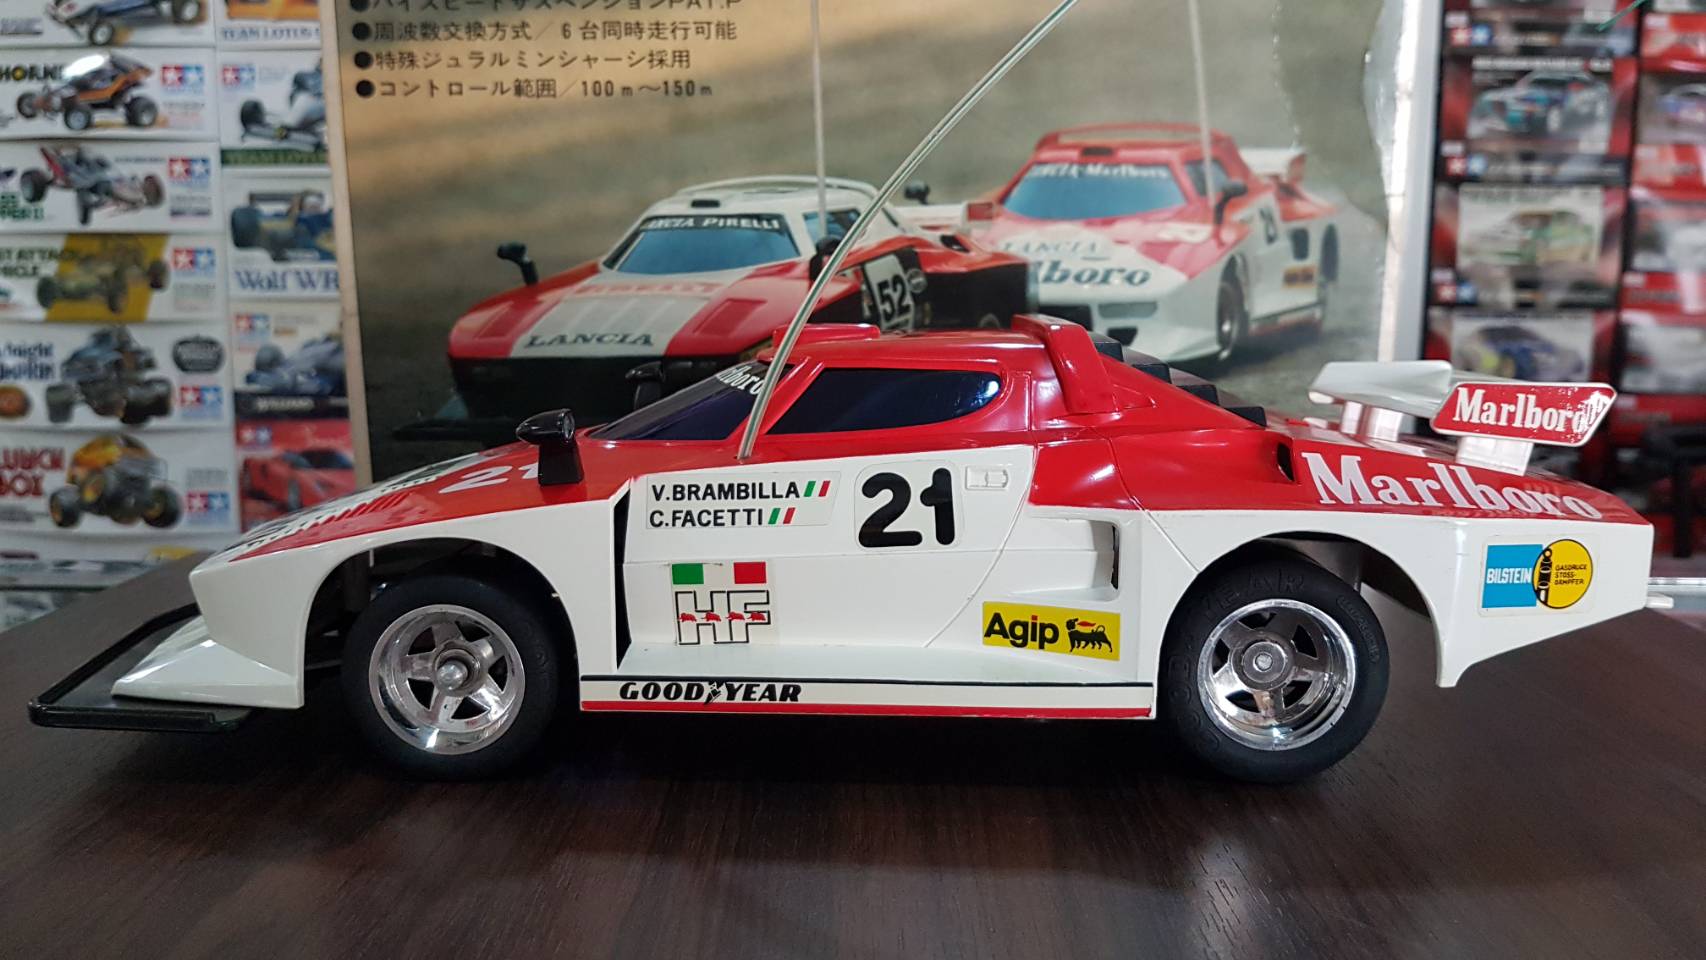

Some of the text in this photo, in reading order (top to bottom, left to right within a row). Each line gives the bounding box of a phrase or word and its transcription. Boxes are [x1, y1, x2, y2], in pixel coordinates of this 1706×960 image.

[701, 218, 780, 230] PIRELLI
[878, 274, 911, 323] 52
[524, 332, 654, 348] LANCIA
[1452, 386, 1589, 434] Marlboro
[652, 481, 800, 502] V.BRAMBILLA
[1302, 452, 1602, 520] Marlboro
[650, 508, 763, 528] C.FACETTI
[858, 467, 955, 548] 21
[1486, 567, 1533, 584] BILSTEIN
[675, 590, 772, 646] HF
[984, 612, 1060, 650] Agip
